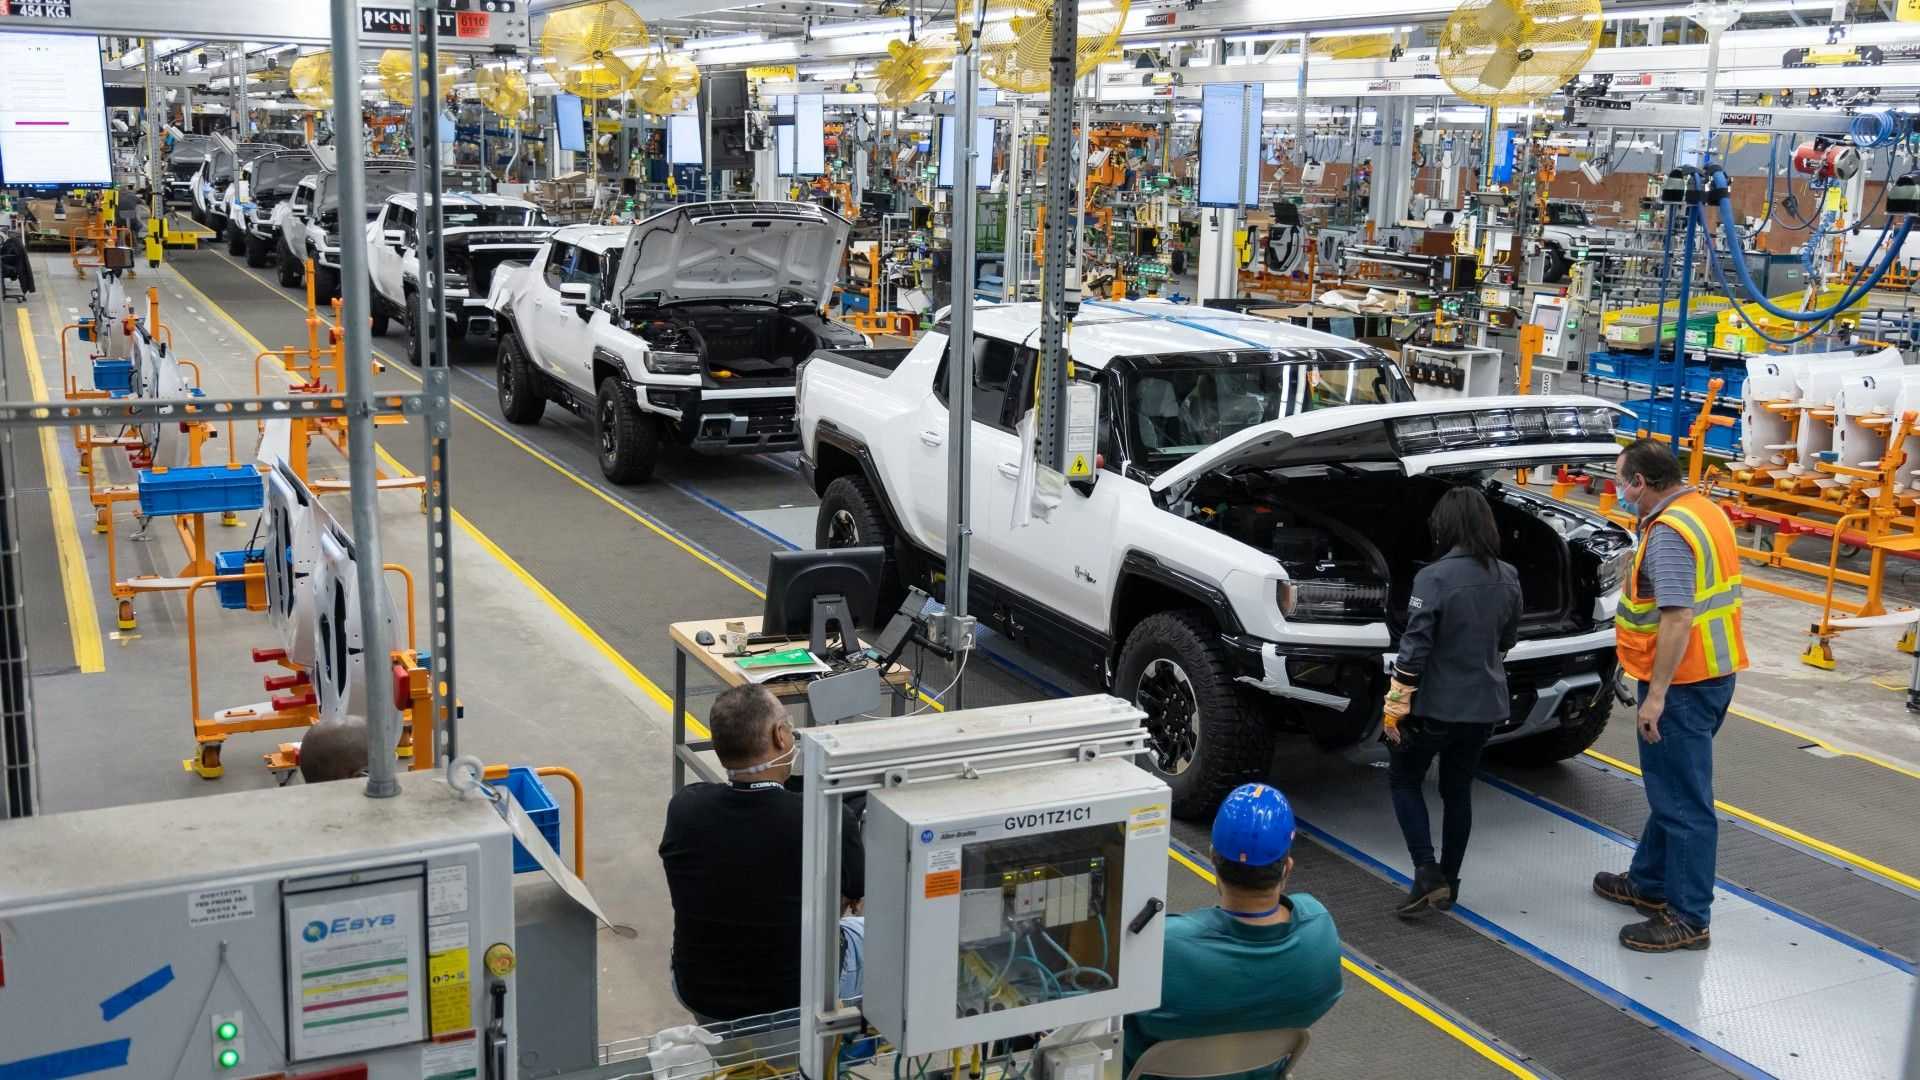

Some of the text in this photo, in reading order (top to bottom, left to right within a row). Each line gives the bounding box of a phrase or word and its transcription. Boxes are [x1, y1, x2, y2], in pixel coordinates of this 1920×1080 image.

[20, 5, 42, 17] 454
[374, 11, 454, 27] KNIT
[1004, 806, 1091, 830] GVD1TZ1C1
